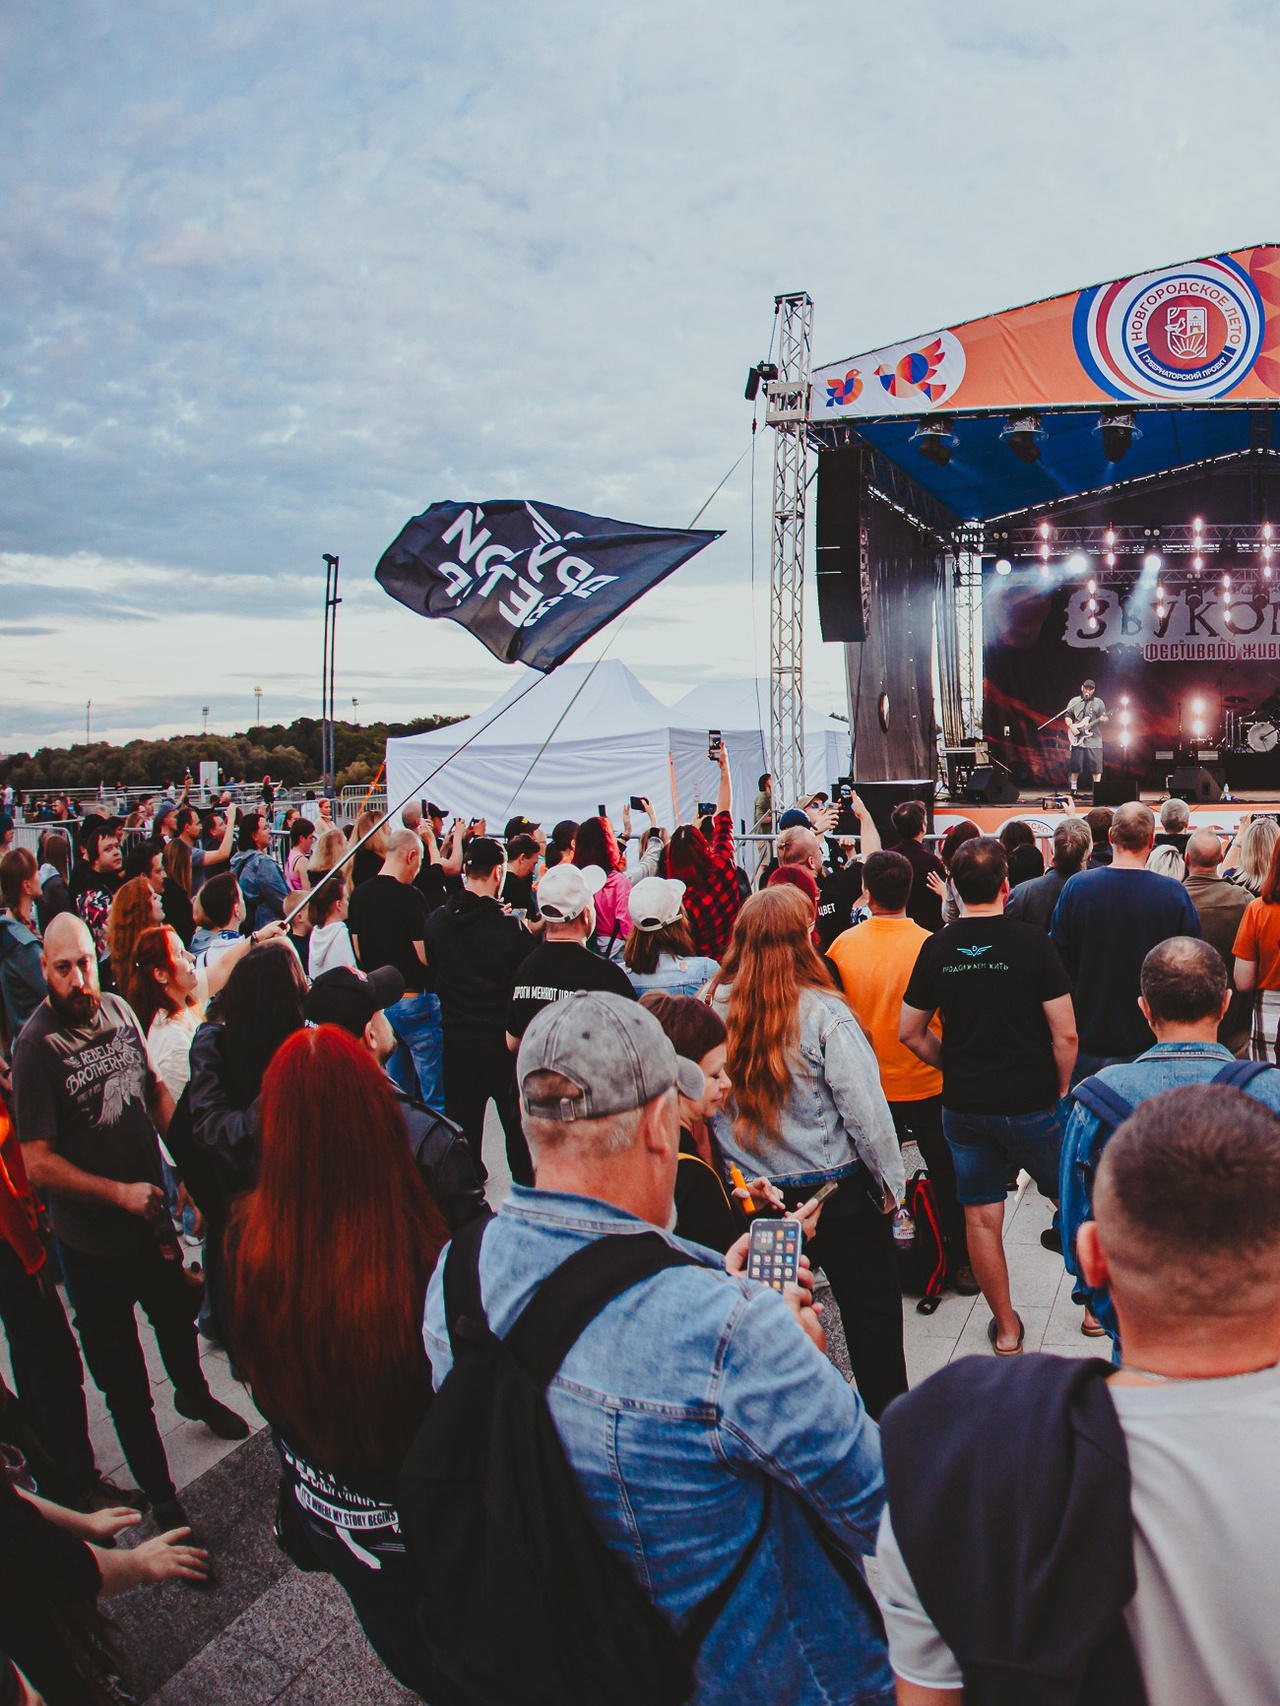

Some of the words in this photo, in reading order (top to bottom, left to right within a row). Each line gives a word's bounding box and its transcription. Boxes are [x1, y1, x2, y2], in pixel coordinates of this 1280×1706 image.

[1131, 282, 1230, 341] НОВГОРОДСКОЕ
[1225, 307, 1242, 345] ЛЕТО
[1142, 354, 1202, 380] ГУБЕРНАТОРСКИЙ
[1202, 356, 1227, 377] ПРОЕКТ
[1145, 641, 1238, 661] ФЕСТИВАЛЬ
[817, 902, 836, 917] ЦВЕТ
[79, 1043, 115, 1066] REBELS
[65, 1050, 143, 1096] BROTHERHOO
[332, 1509, 343, 1524] MY
[344, 1512, 367, 1527] STORY
[367, 1510, 396, 1527] BEGINS
